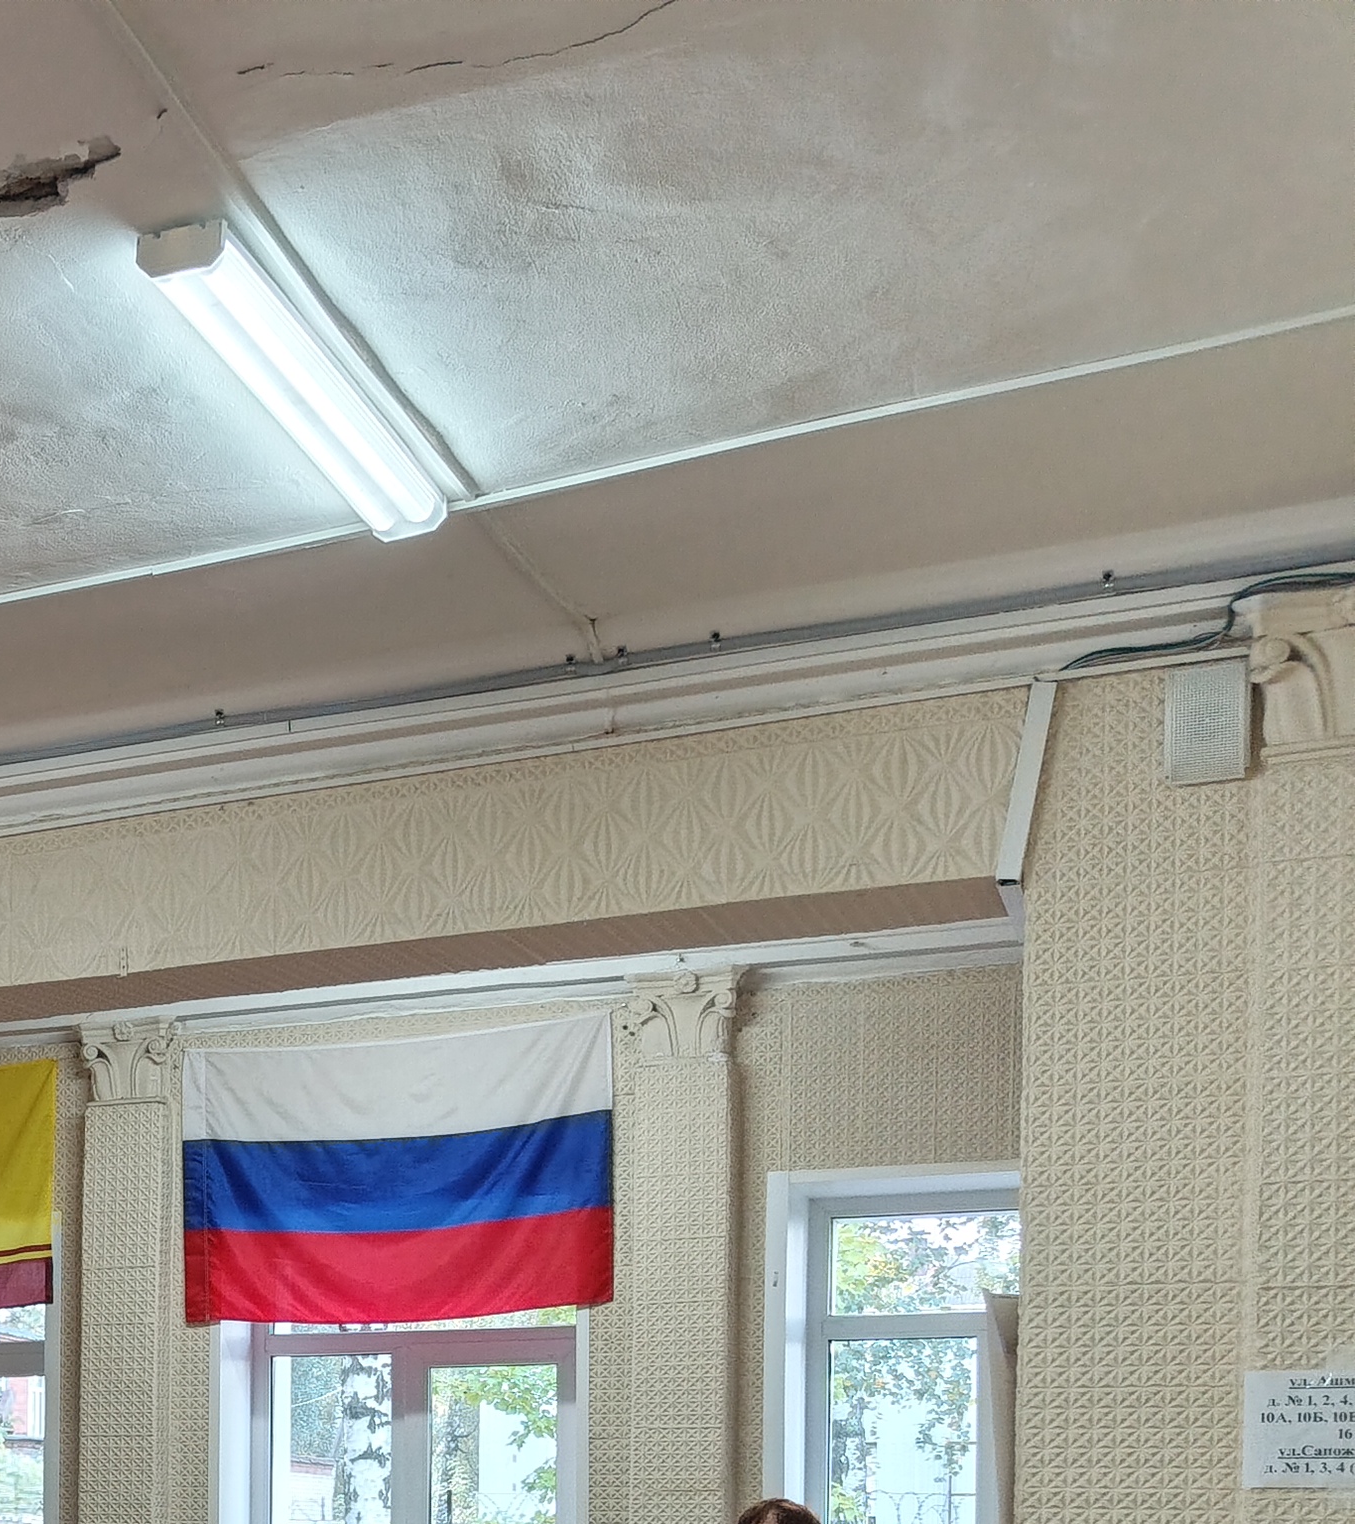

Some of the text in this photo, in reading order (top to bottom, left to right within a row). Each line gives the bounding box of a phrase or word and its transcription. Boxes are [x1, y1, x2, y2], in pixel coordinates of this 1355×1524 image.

[1284, 1395, 1303, 1406] №
[1282, 1462, 1300, 1473] №
[1336, 1462, 1345, 1473] 4
